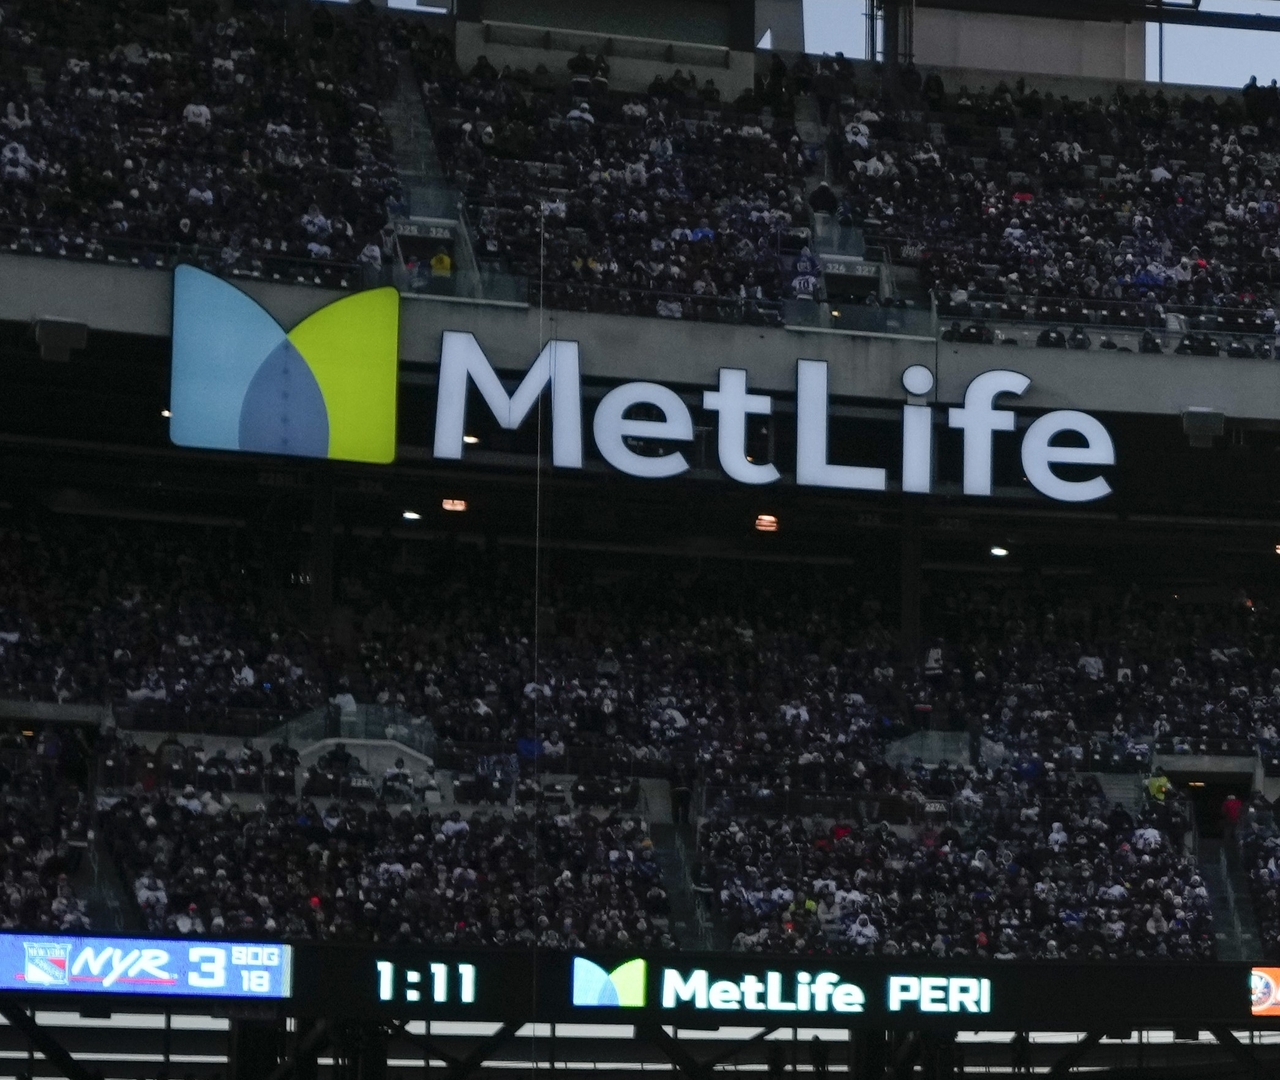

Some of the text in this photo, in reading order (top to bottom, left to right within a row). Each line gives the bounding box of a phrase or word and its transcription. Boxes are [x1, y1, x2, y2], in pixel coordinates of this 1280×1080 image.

[433, 331, 1116, 502] MetLife
[71, 945, 169, 987] NYR
[187, 946, 227, 988] 3
[231, 945, 279, 966] SOG
[241, 969, 270, 992] 18
[376, 959, 476, 1003] 1:11
[661, 968, 992, 1013] MetLife PERI
